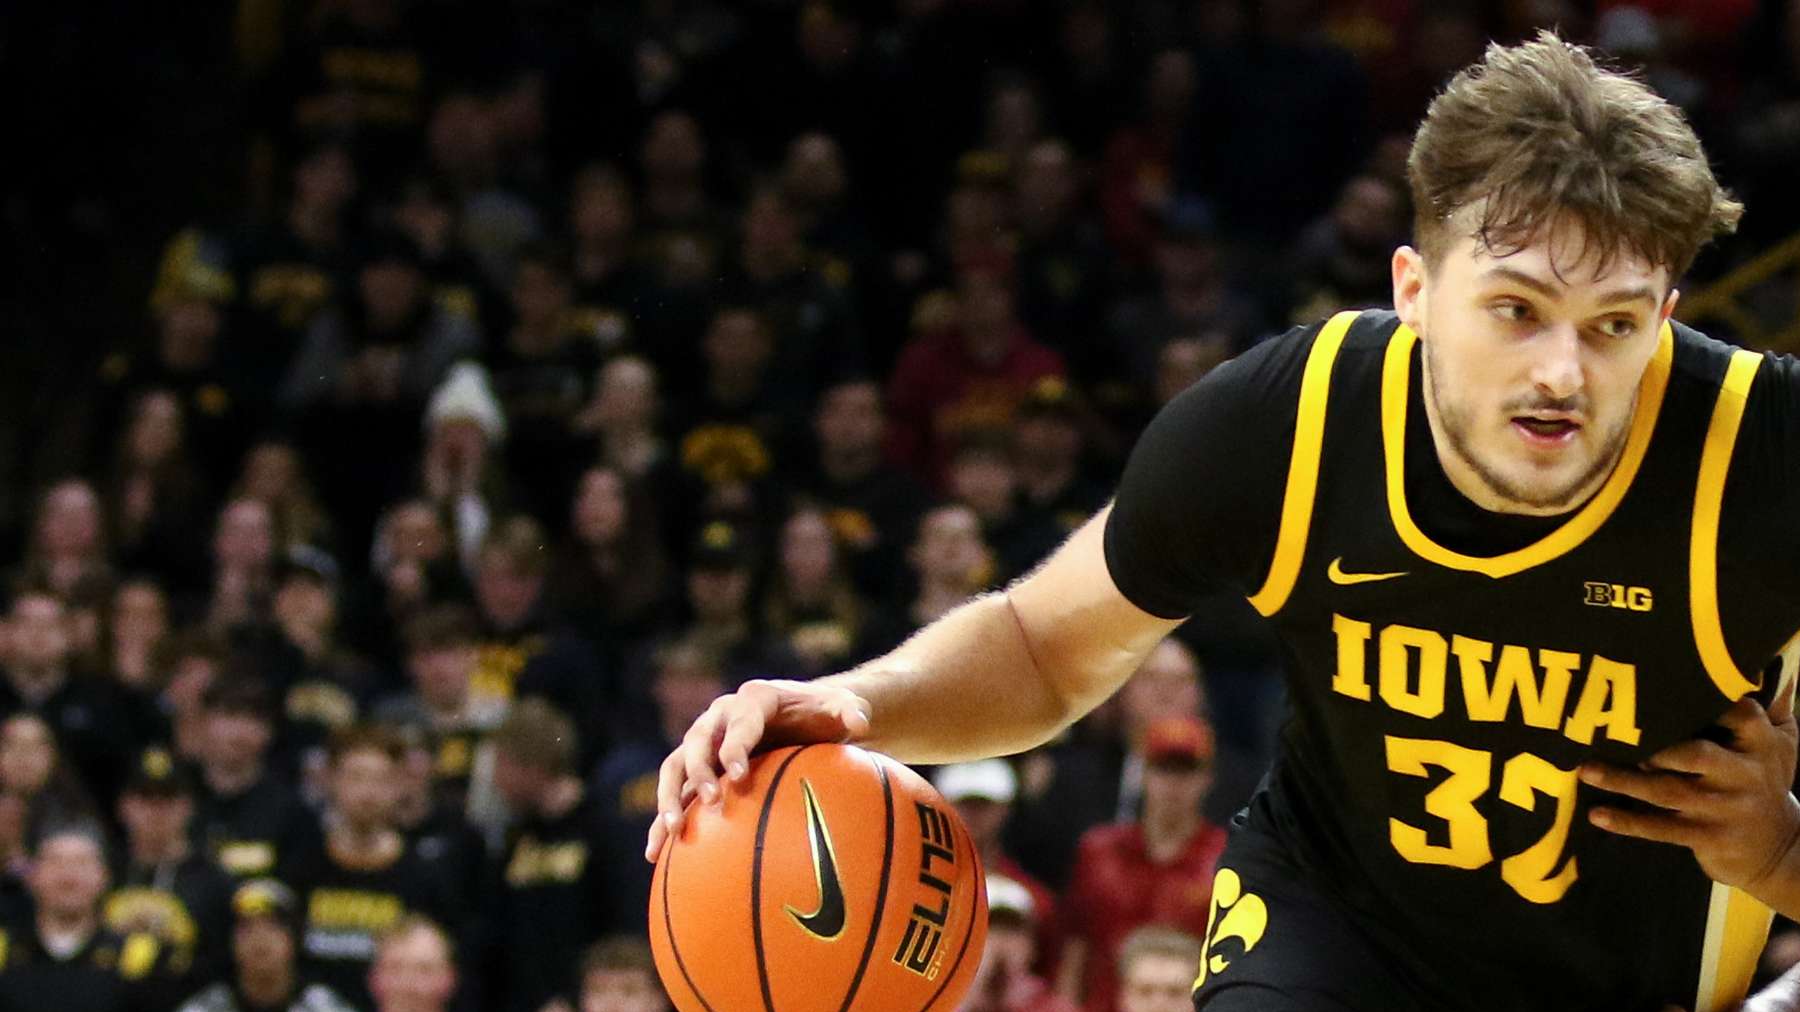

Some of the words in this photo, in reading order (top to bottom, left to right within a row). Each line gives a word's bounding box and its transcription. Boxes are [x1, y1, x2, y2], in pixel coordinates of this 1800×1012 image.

[1332, 612, 1642, 746] IOWA
[893, 801, 954, 977] ELITE
[1384, 734, 1580, 904] 32
